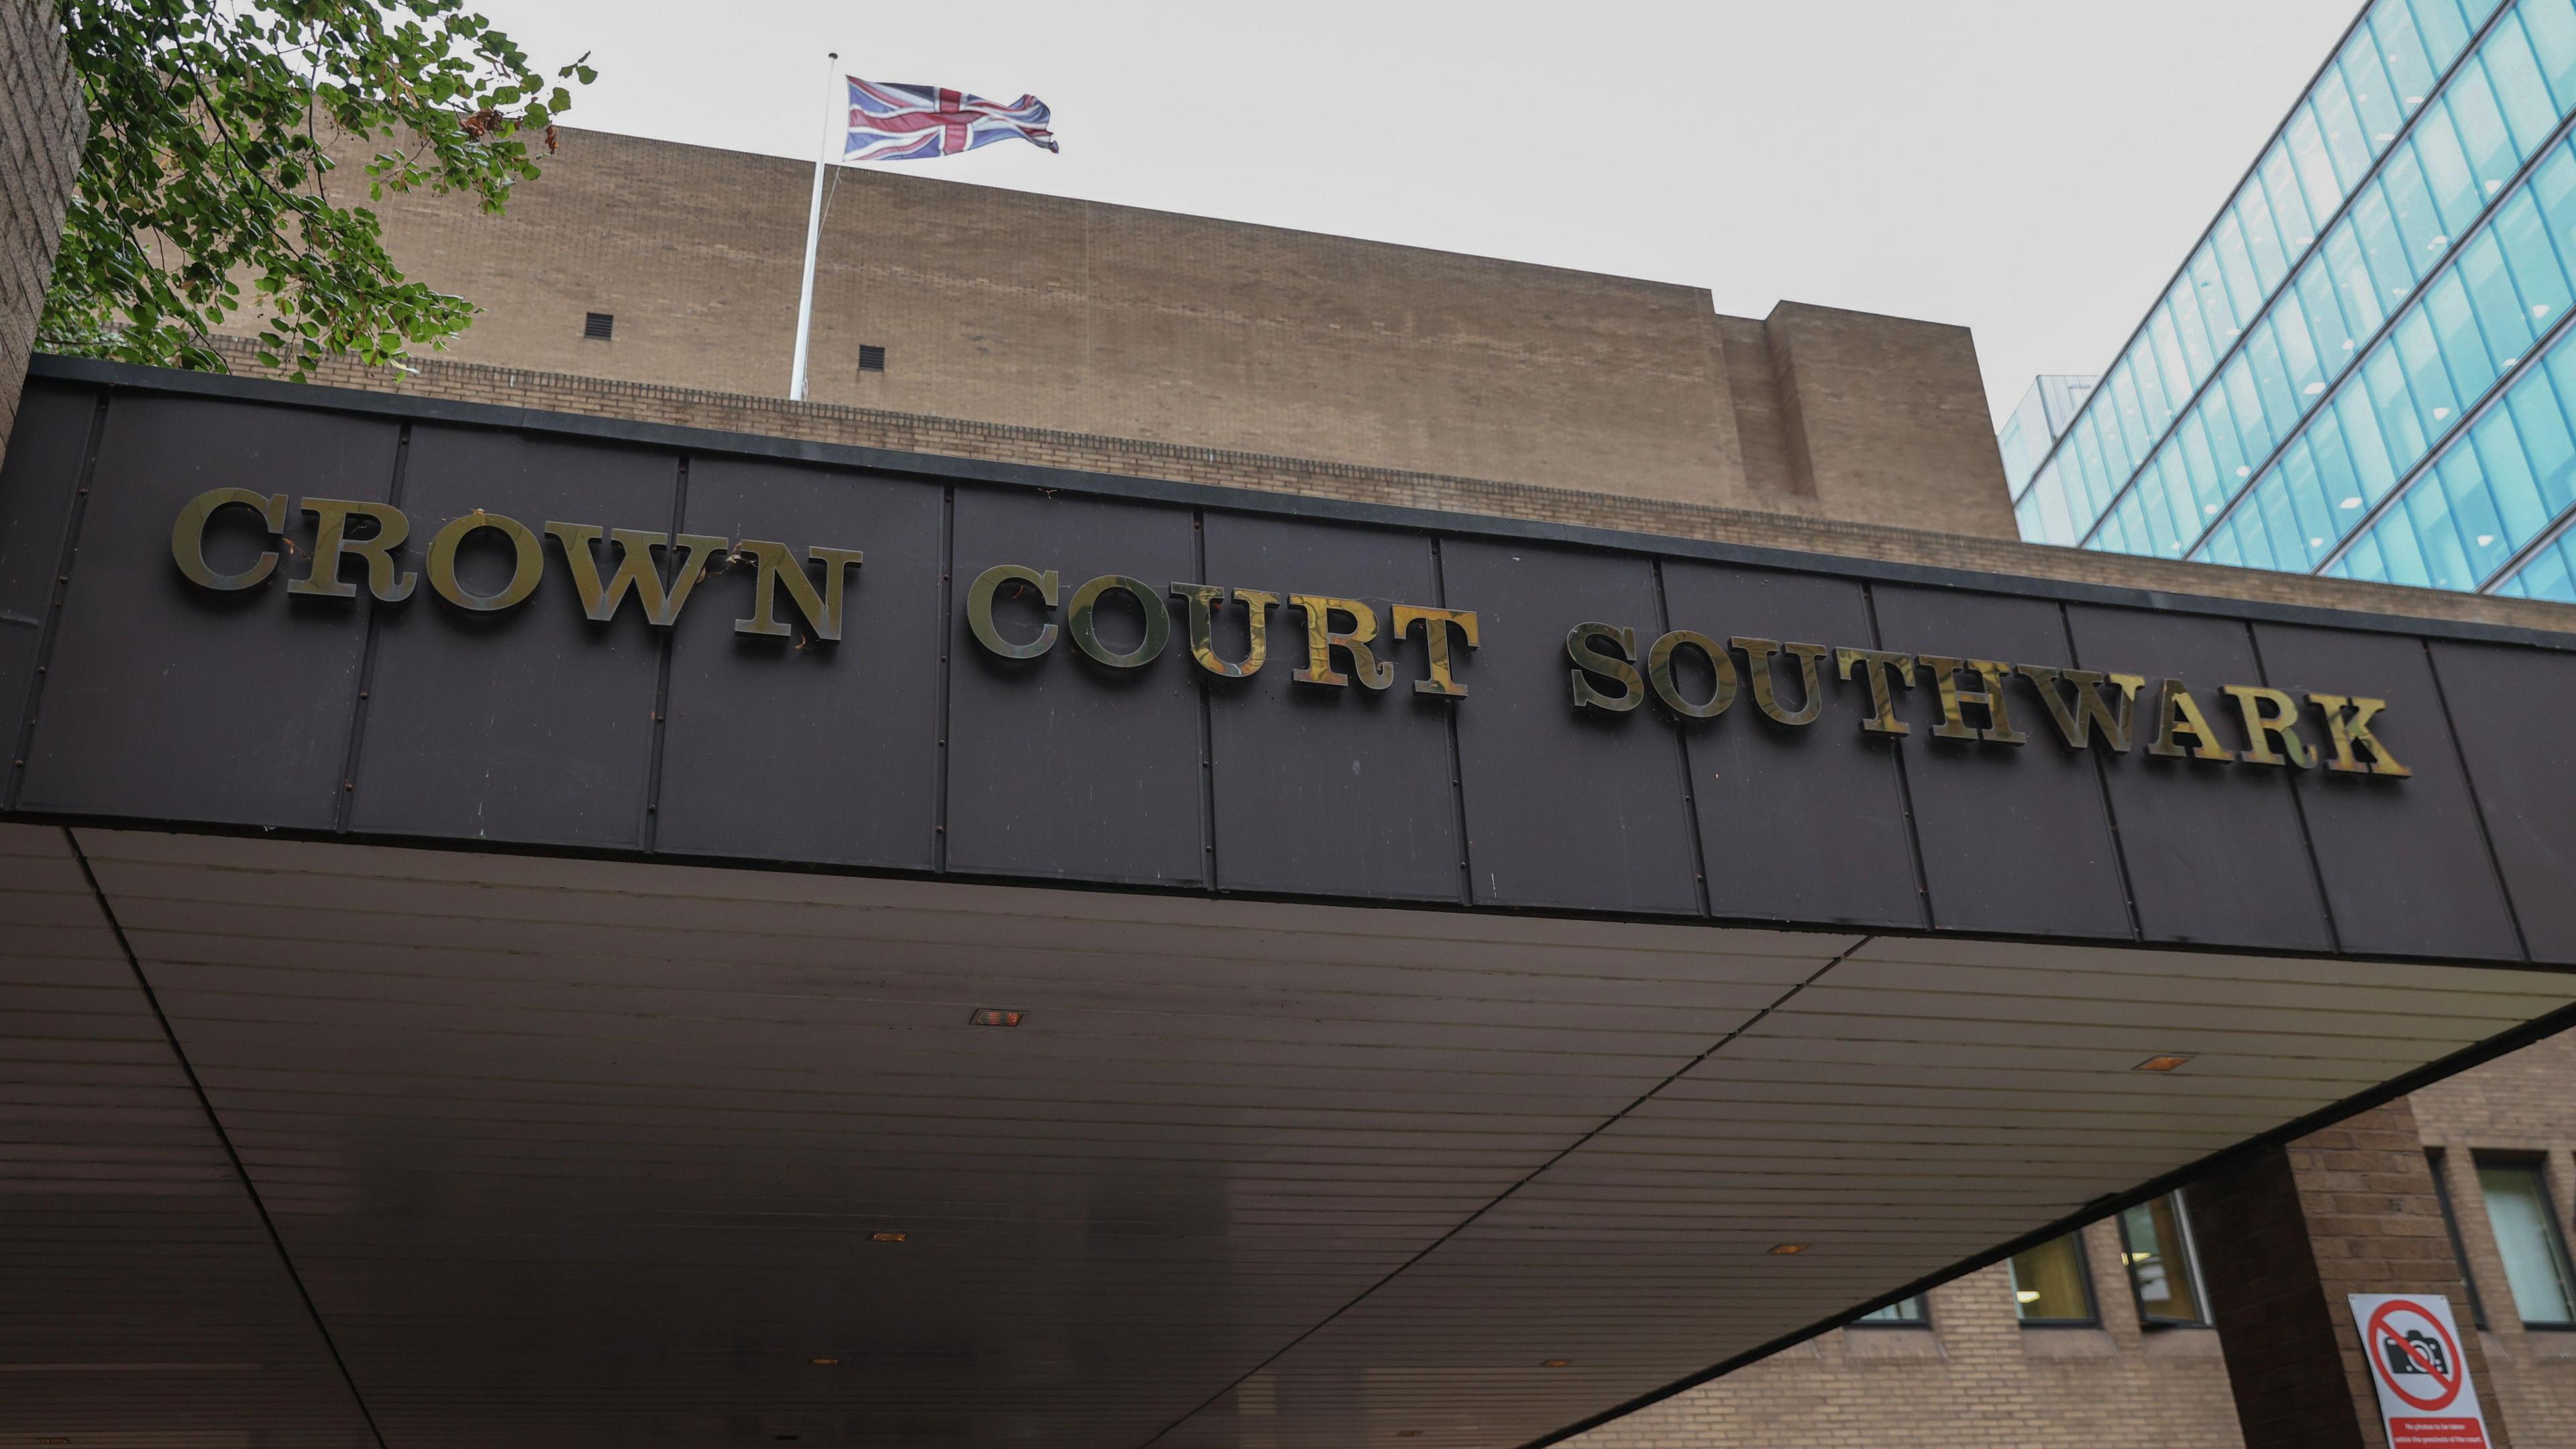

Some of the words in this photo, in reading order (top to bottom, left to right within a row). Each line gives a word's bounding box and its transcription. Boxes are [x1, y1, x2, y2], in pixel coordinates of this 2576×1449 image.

[172, 487, 864, 644] CROWN
[966, 564, 1481, 700] COURT
[1566, 621, 2412, 779] SOUTHWARK
